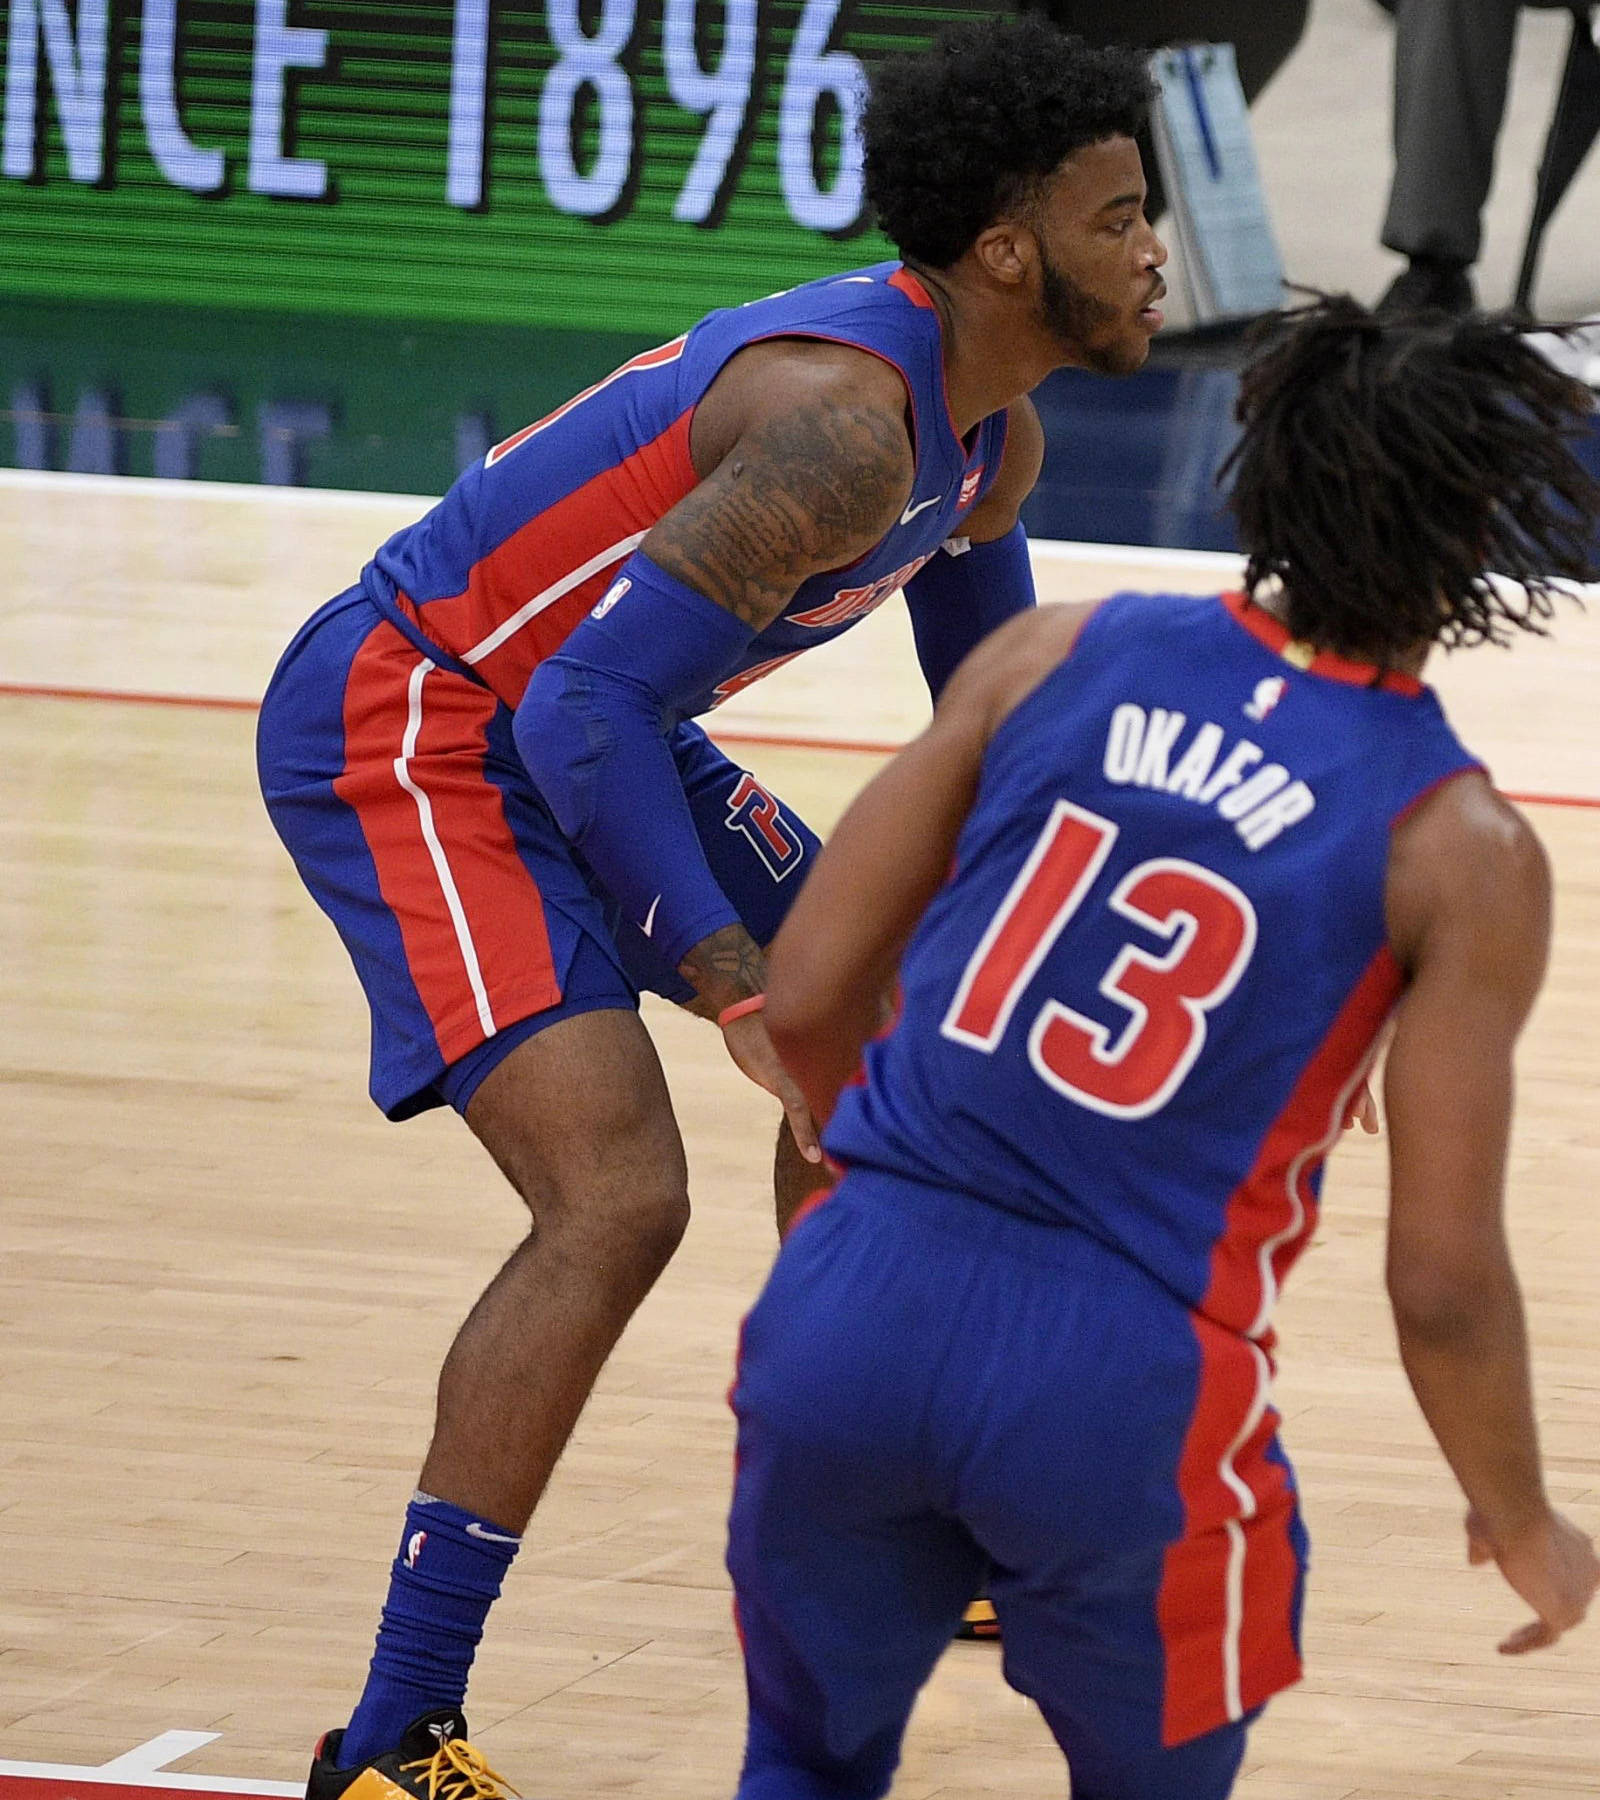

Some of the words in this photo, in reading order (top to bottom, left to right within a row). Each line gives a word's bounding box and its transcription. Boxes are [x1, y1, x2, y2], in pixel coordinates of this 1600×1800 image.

[446, 0, 864, 232] 1896
[1103, 702, 1316, 852] OKAFOR
[940, 798, 1258, 1119] 13
